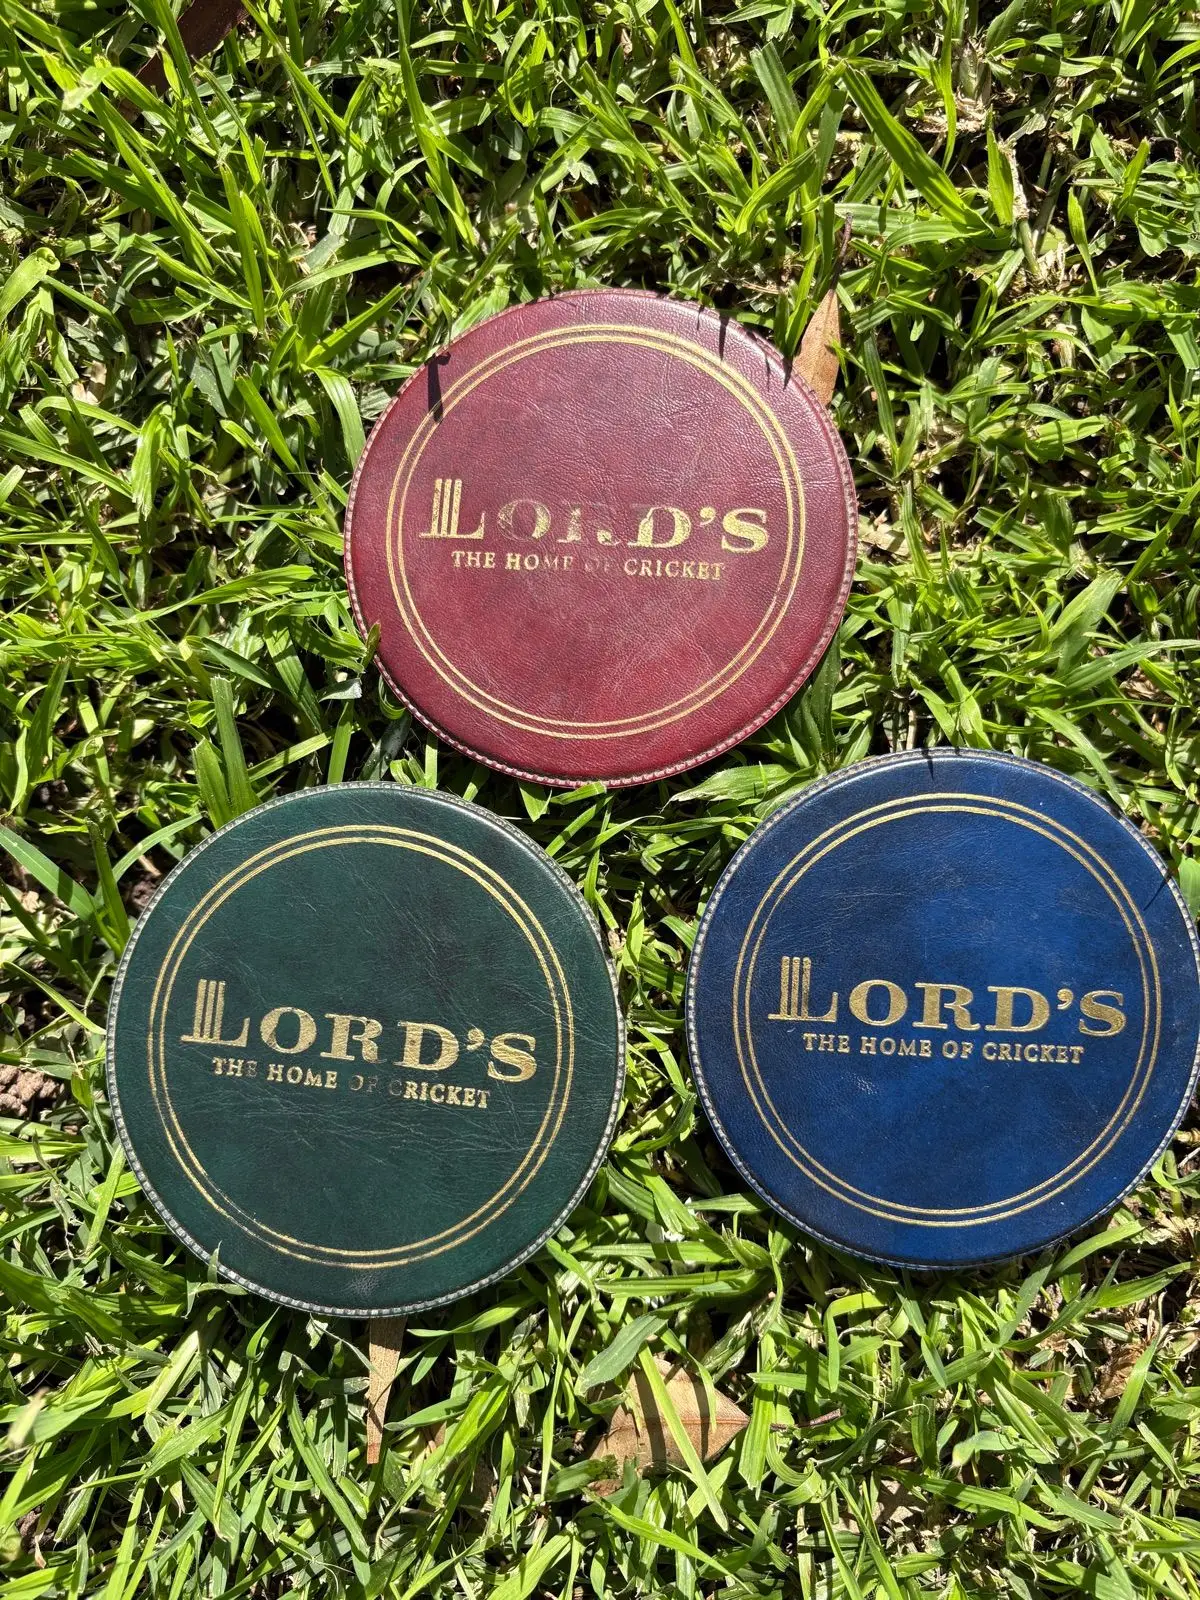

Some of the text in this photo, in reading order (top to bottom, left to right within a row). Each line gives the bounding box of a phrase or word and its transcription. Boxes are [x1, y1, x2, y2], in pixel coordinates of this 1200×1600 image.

[451, 551, 496, 570] THE
[505, 552, 574, 573] HOME
[624, 558, 727, 581] CRICKET
[767, 955, 1127, 1038] LORD'S
[180, 978, 538, 1083] LORD'S
[803, 1032, 1085, 1066] THE HOME OF CRICKET
[211, 1056, 491, 1110] THE HOME OF CRICKET
